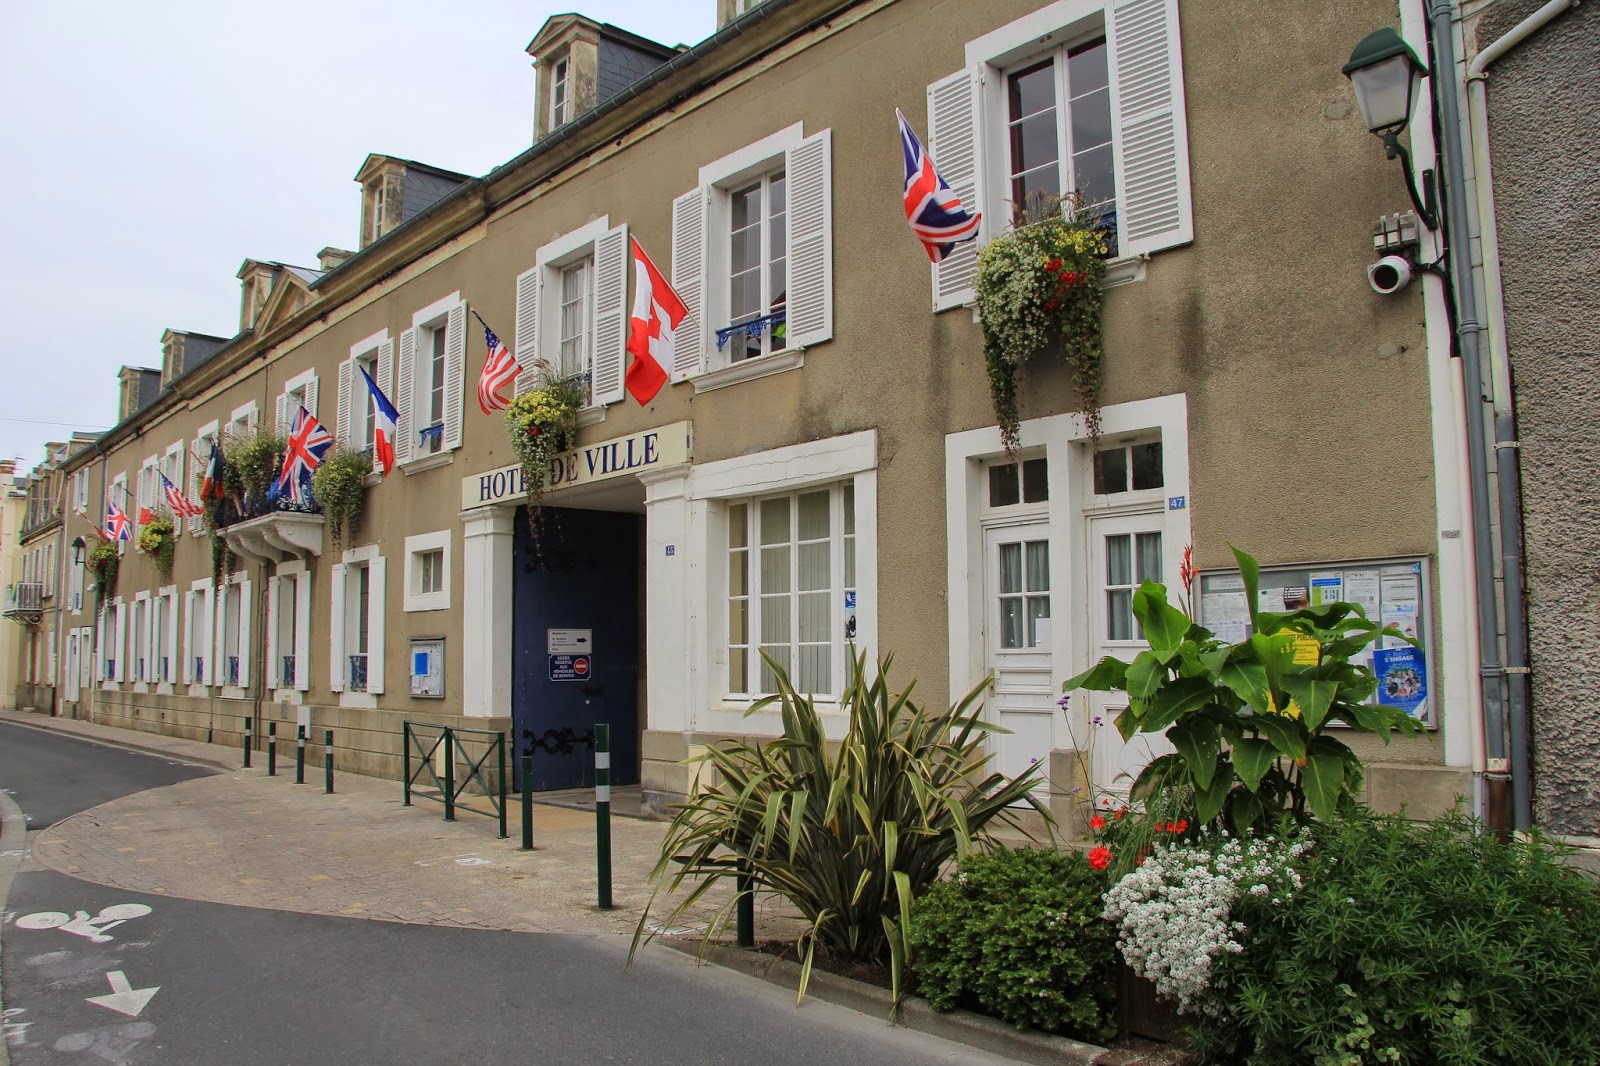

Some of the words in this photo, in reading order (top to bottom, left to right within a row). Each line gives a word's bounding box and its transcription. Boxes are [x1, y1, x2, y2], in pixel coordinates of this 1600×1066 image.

[479, 465, 529, 502] HOTE
[550, 453, 579, 486] DE
[584, 432, 660, 477] VILLE
[1170, 498, 1183, 507] 47
[1384, 655, 1414, 663] S'ENGAGE
